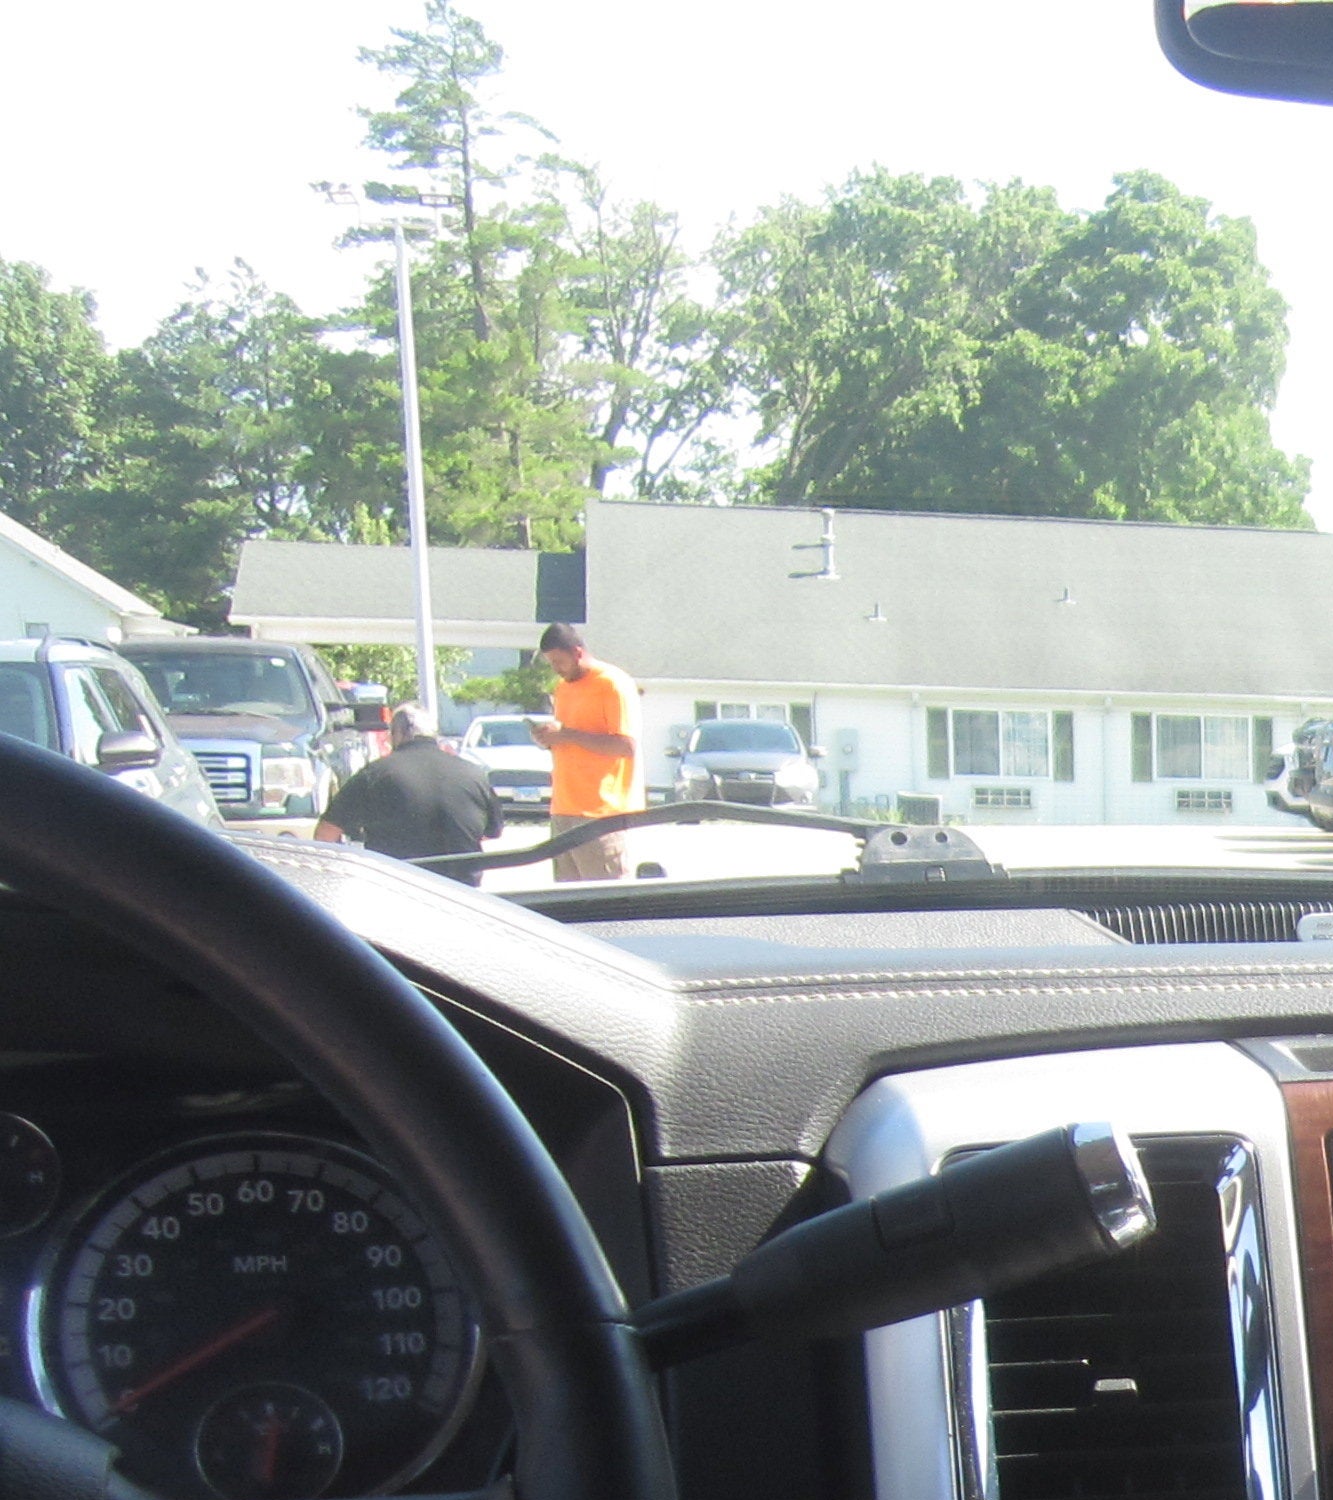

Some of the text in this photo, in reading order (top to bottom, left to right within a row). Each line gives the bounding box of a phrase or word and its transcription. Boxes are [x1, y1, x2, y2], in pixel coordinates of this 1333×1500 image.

[237, 1180, 275, 1203] 60
[287, 1189, 325, 1213] 70
[187, 1193, 224, 1216] 50
[142, 1216, 180, 1239] 40
[332, 1211, 369, 1235] 80
[117, 1255, 153, 1278] 30
[233, 1255, 288, 1273] MPH
[366, 1245, 402, 1268] 90
[97, 1298, 135, 1321] 20
[372, 1286, 422, 1310] 100
[380, 1332, 426, 1356] 110
[100, 1345, 132, 1367] 10
[362, 1377, 412, 1401] 120
